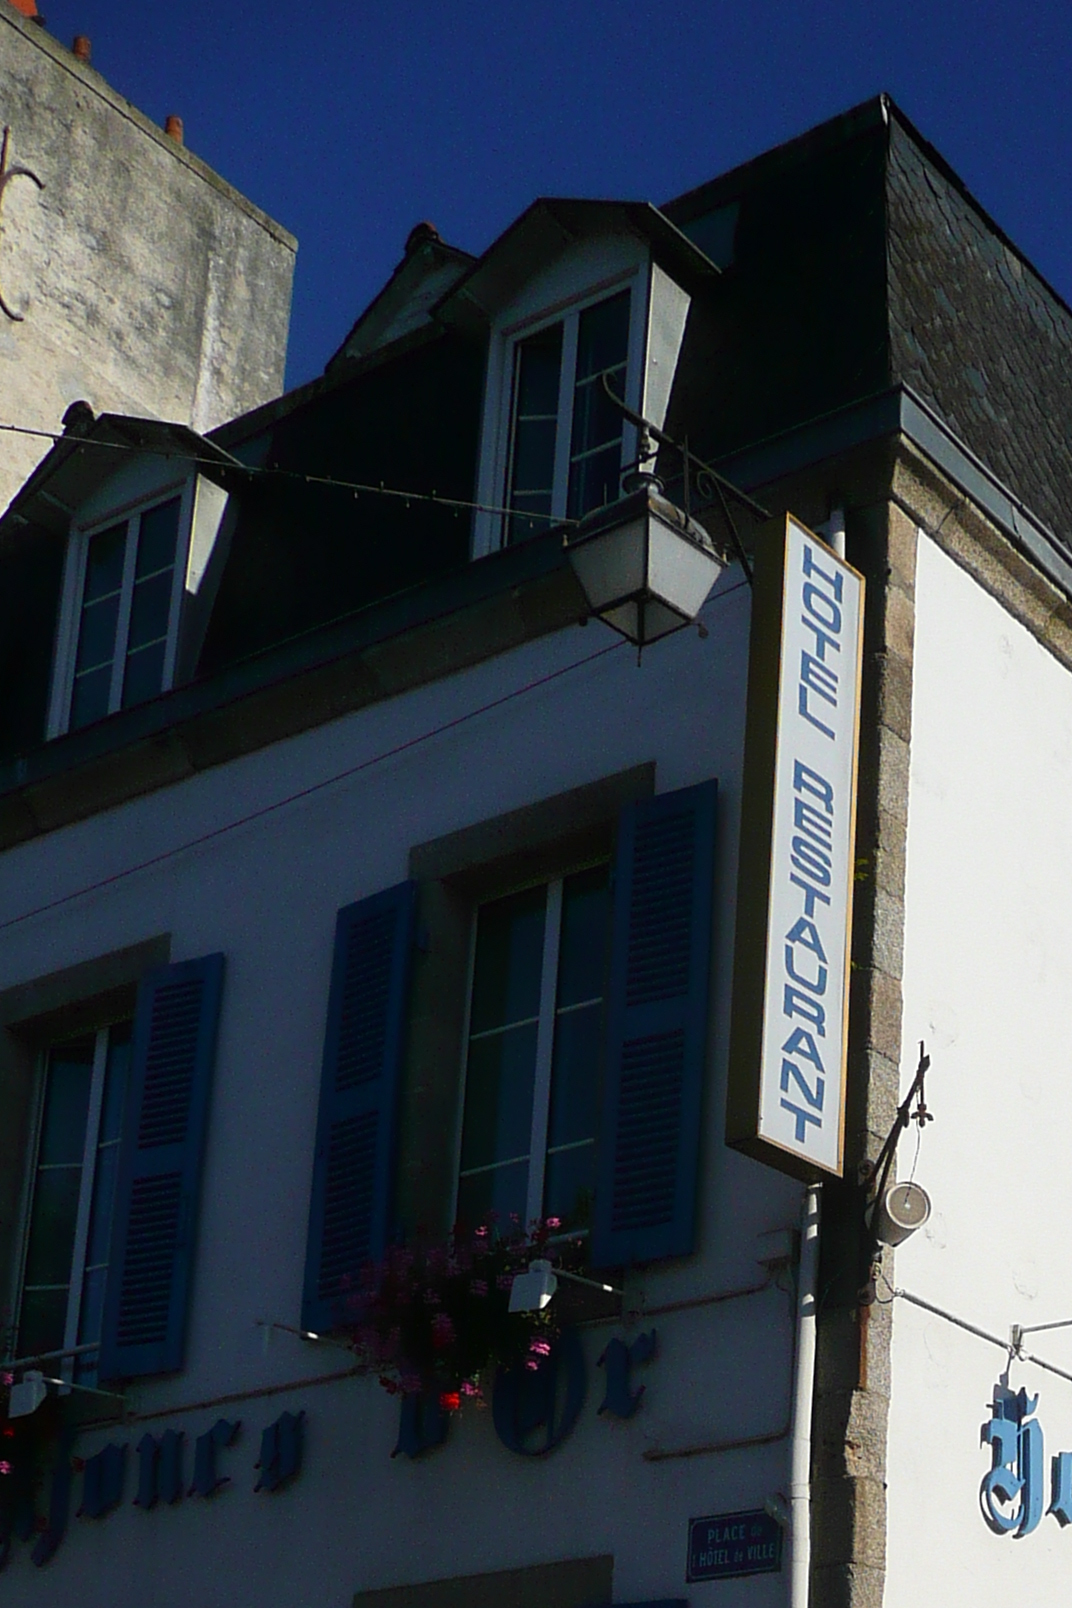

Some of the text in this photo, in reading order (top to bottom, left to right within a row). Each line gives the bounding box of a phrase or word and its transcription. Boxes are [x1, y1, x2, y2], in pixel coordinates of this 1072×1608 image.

[779, 544, 844, 1145] HOTEL RESTAURANT
[0, 1410, 306, 1571] joncs
[707, 1523, 747, 1544] PLACE
[733, 1548, 744, 1563] de
[747, 1542, 775, 1561] VILLE
